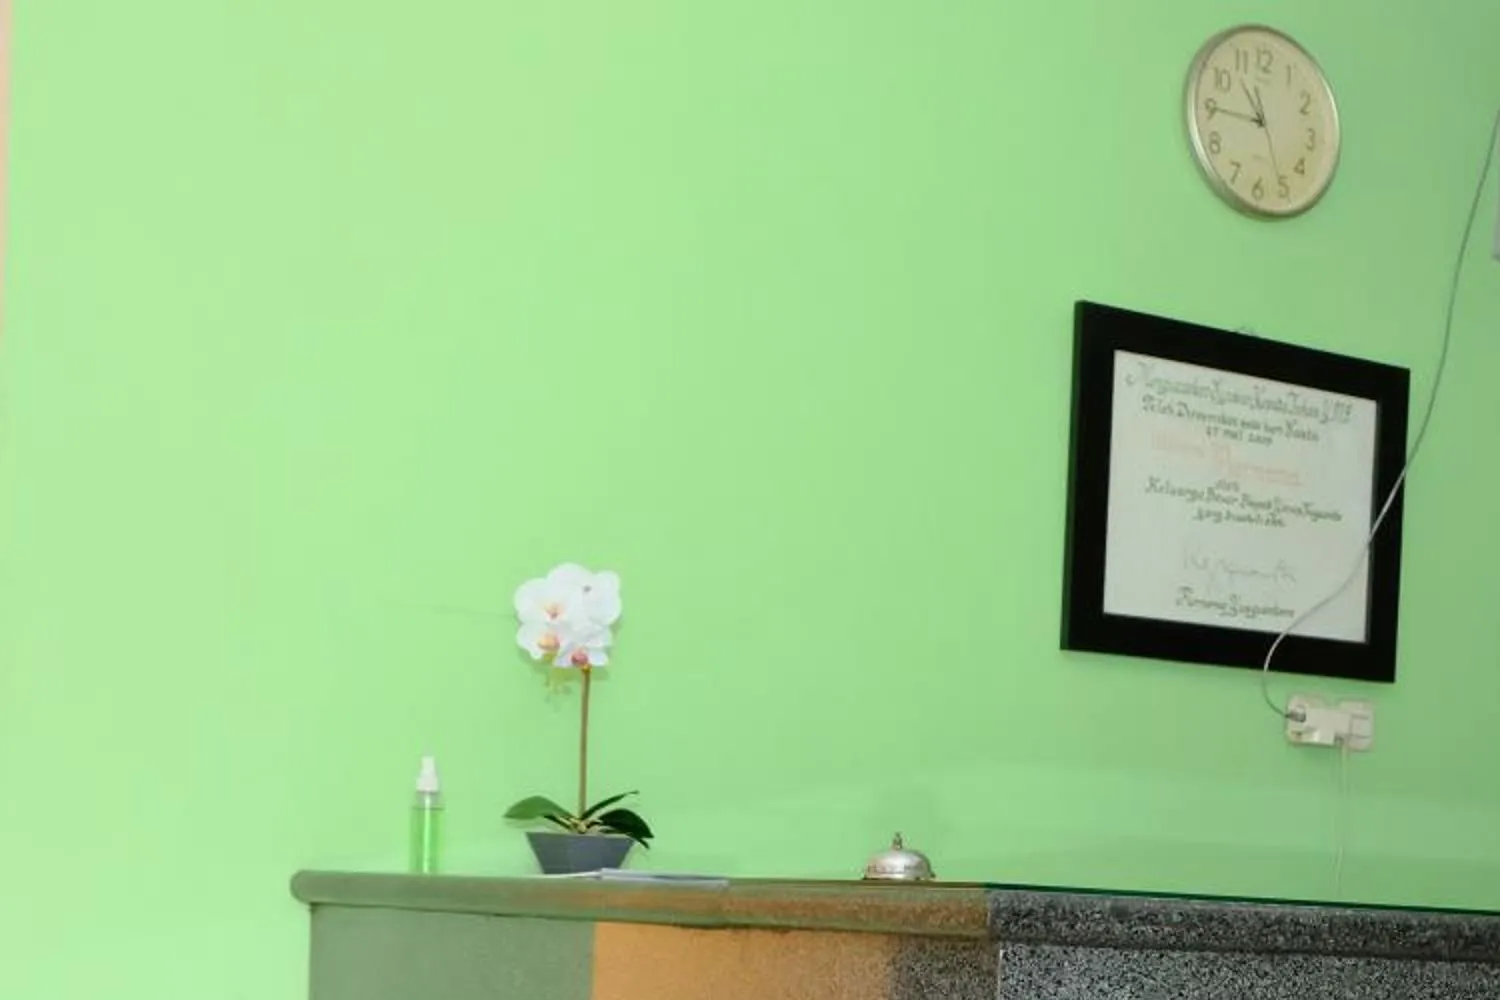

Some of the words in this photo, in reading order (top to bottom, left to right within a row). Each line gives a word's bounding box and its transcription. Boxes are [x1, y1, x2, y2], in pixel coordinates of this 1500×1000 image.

[1235, 49, 1249, 74] 11
[1256, 48, 1274, 75] 12
[1213, 67, 1231, 92] 10
[1204, 98, 1217, 121] 9
[1299, 91, 1312, 116] 2
[1208, 131, 1222, 155] 8
[1306, 128, 1316, 151] 3
[1229, 161, 1242, 184] 7
[1293, 157, 1306, 175] 4
[1250, 178, 1265, 201] 6
[1277, 176, 1290, 198] 5
